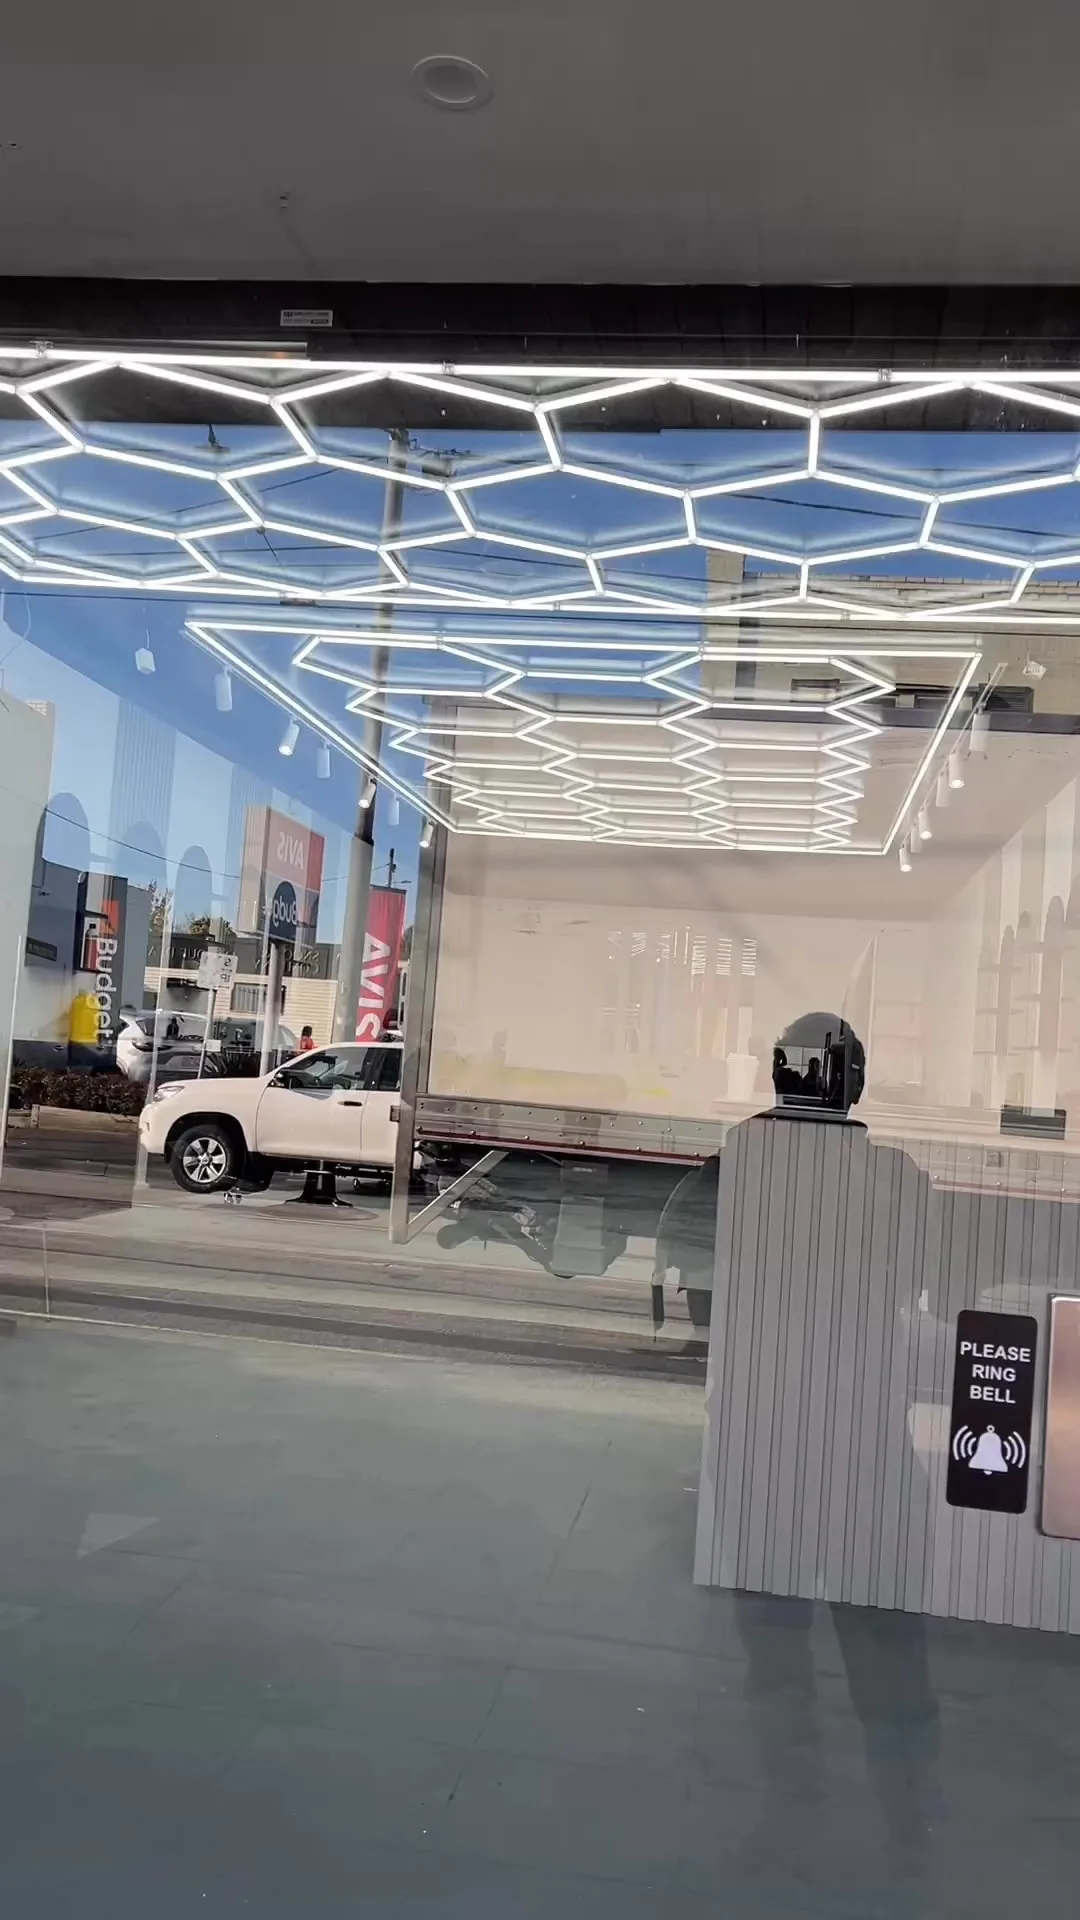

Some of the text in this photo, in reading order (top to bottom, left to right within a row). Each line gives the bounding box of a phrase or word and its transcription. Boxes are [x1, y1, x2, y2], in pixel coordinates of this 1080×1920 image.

[87, 938, 118, 1040] Budget
[357, 934, 390, 1040] AVIS
[960, 1341, 1031, 1363] PLEASE
[972, 1364, 1016, 1382] RING
[970, 1386, 1016, 1404] BELL
